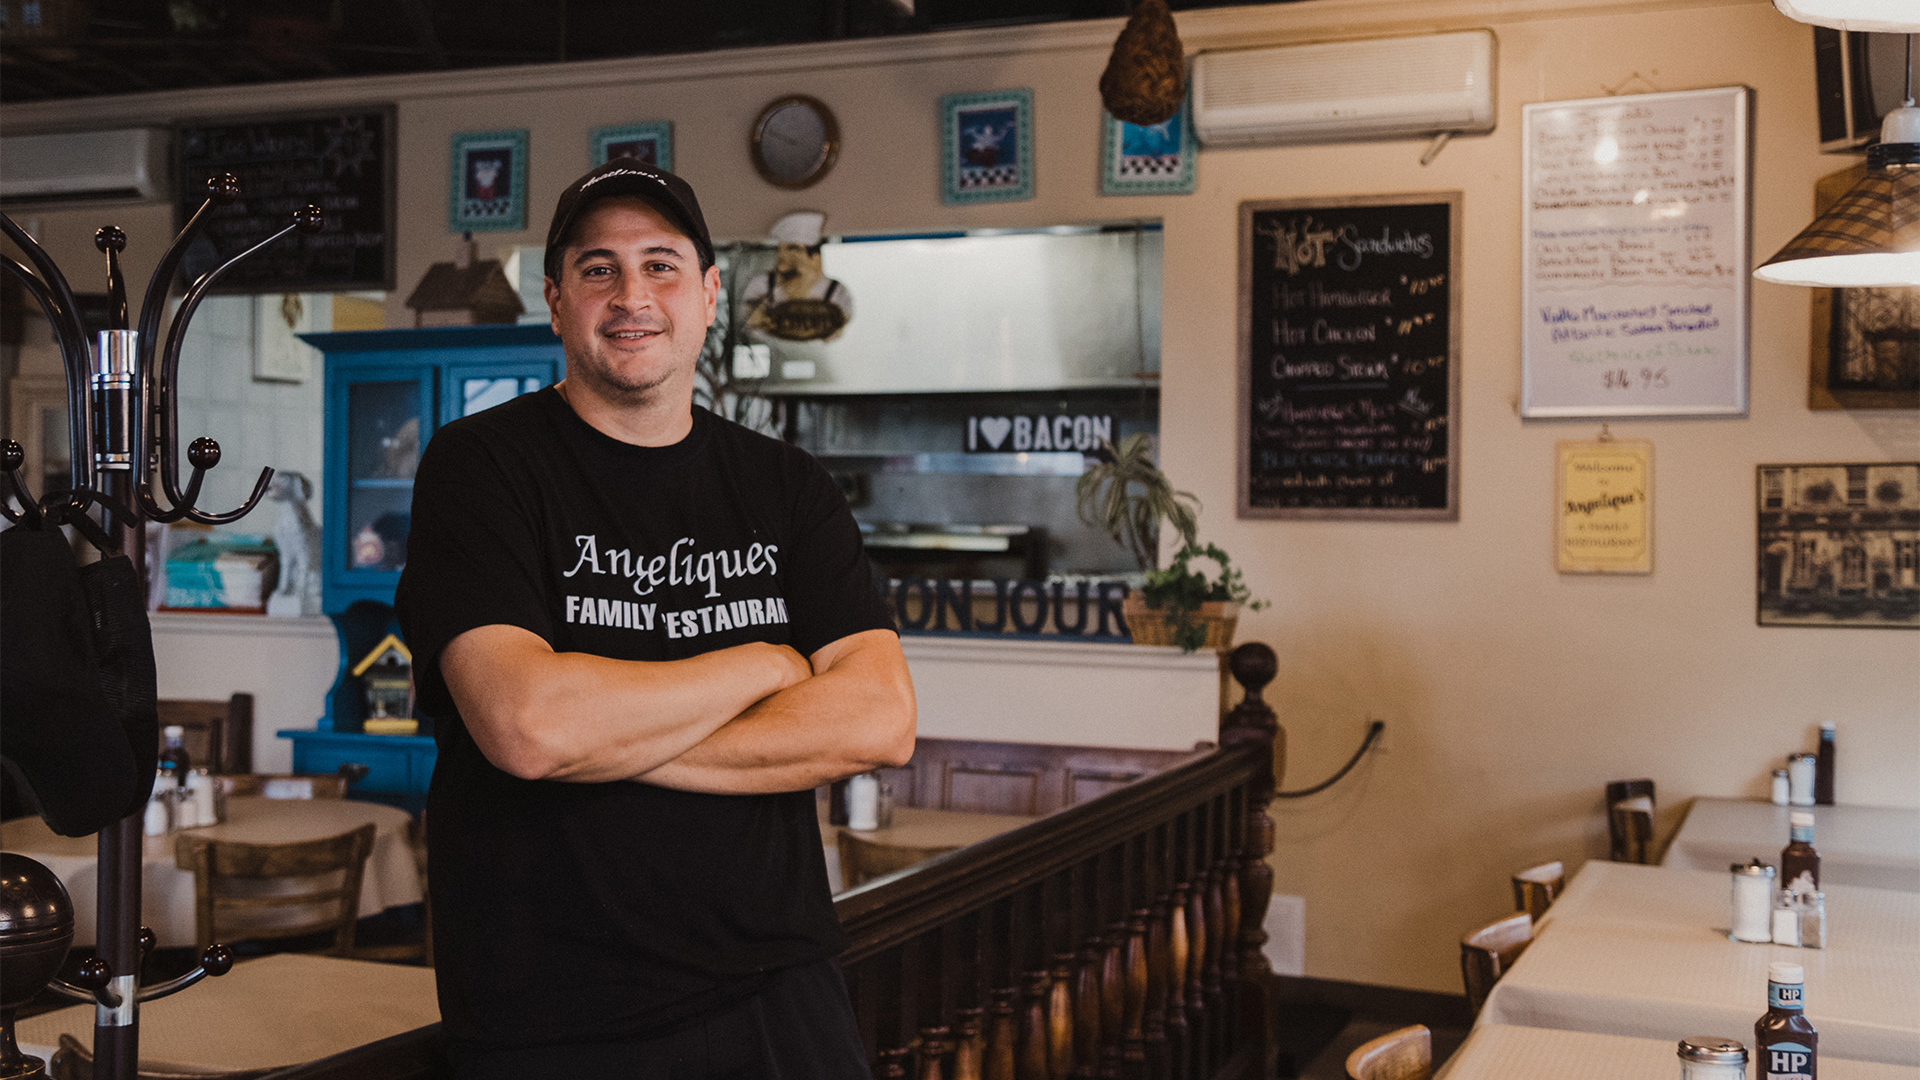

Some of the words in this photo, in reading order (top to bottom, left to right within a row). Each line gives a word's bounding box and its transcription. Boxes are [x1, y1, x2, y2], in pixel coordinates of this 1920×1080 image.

[1013, 415, 1112, 451] BACON
[566, 595, 657, 631] FAMILY
[661, 597, 790, 639] ESTAURAN
[1783, 989, 1800, 1000] HP
[1771, 1051, 1808, 1073] HP
